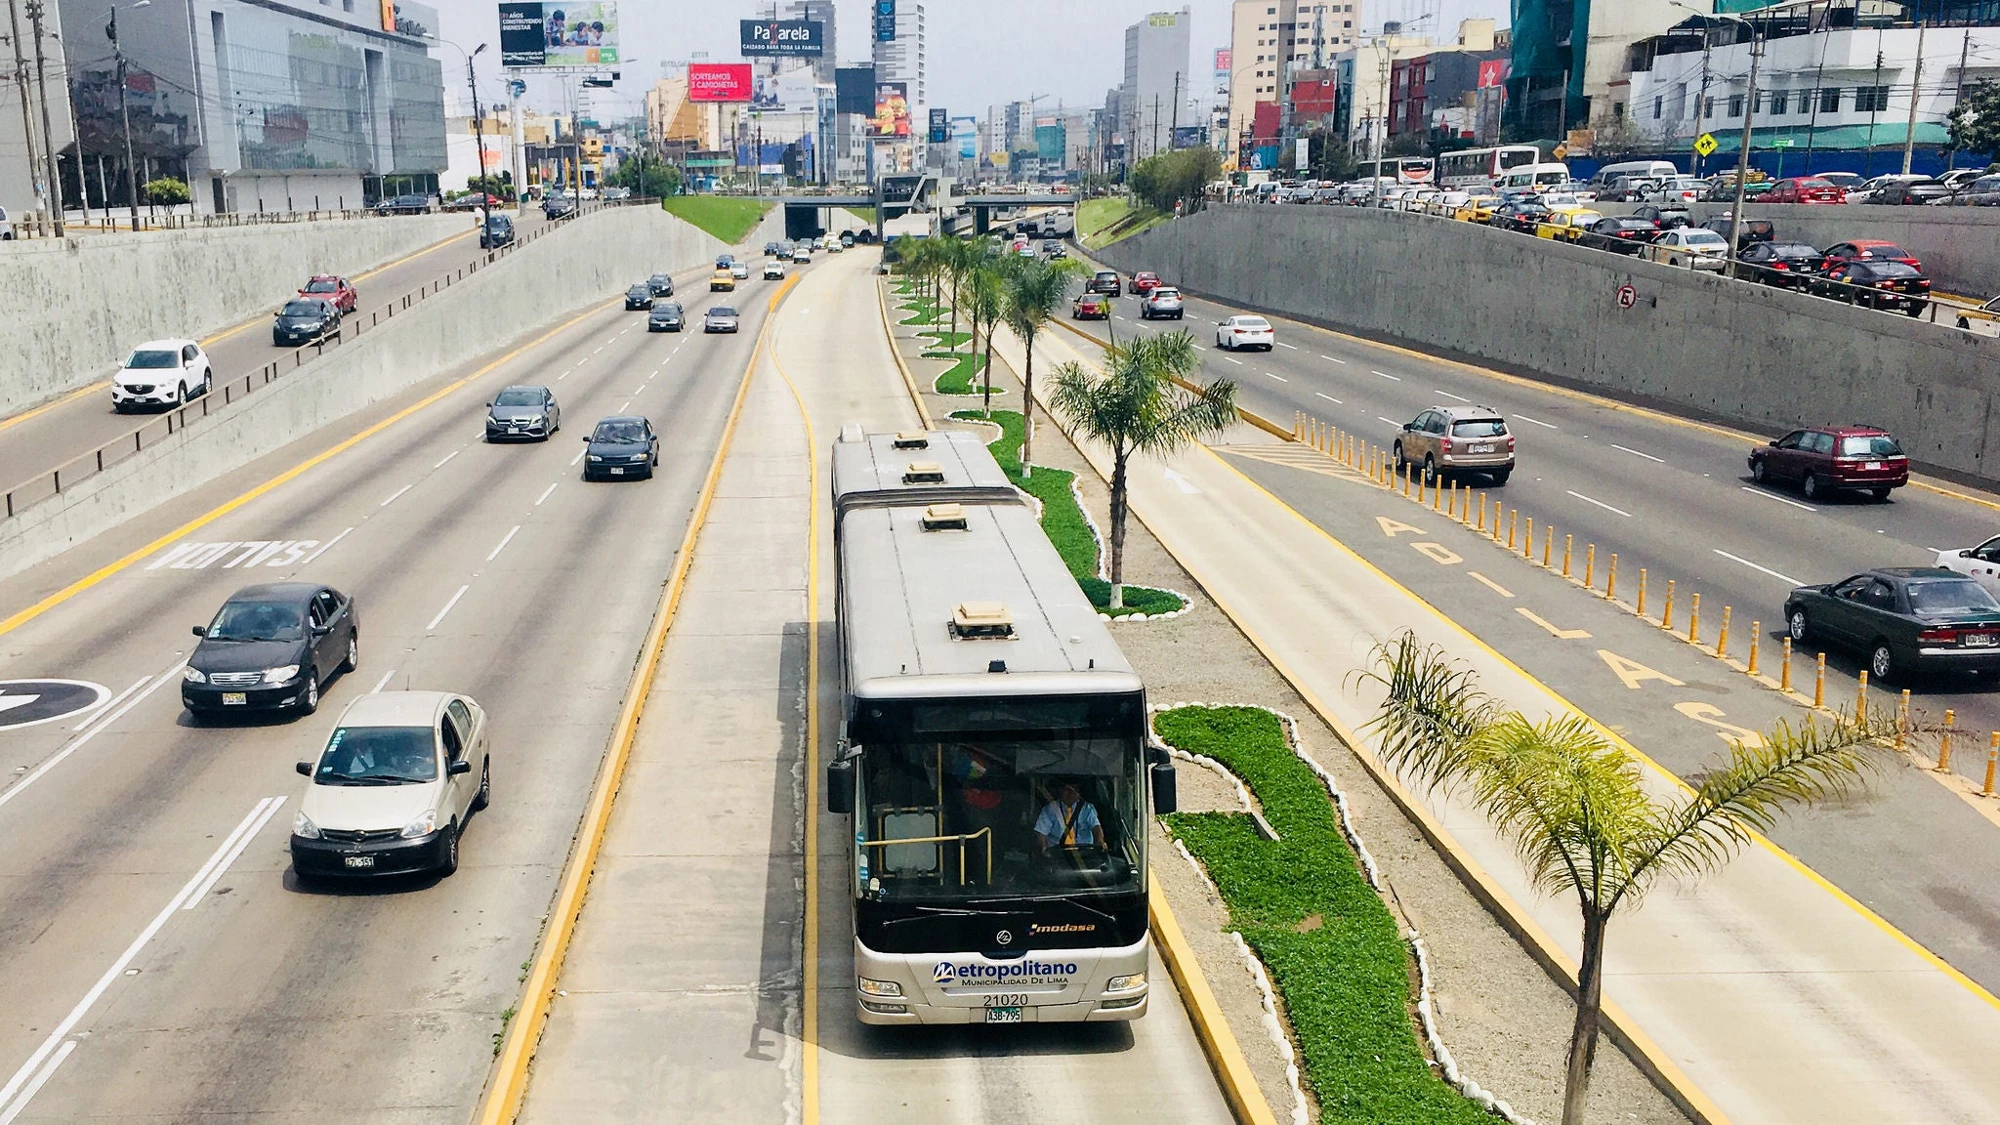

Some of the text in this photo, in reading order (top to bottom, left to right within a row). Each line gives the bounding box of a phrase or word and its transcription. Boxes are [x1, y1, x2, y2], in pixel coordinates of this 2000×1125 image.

[696, 81, 738, 89] CAMIONETAS
[1036, 923, 1096, 933] modasa
[983, 994, 1029, 1007] 21020
[988, 1009, 1021, 1021] A3B-795
